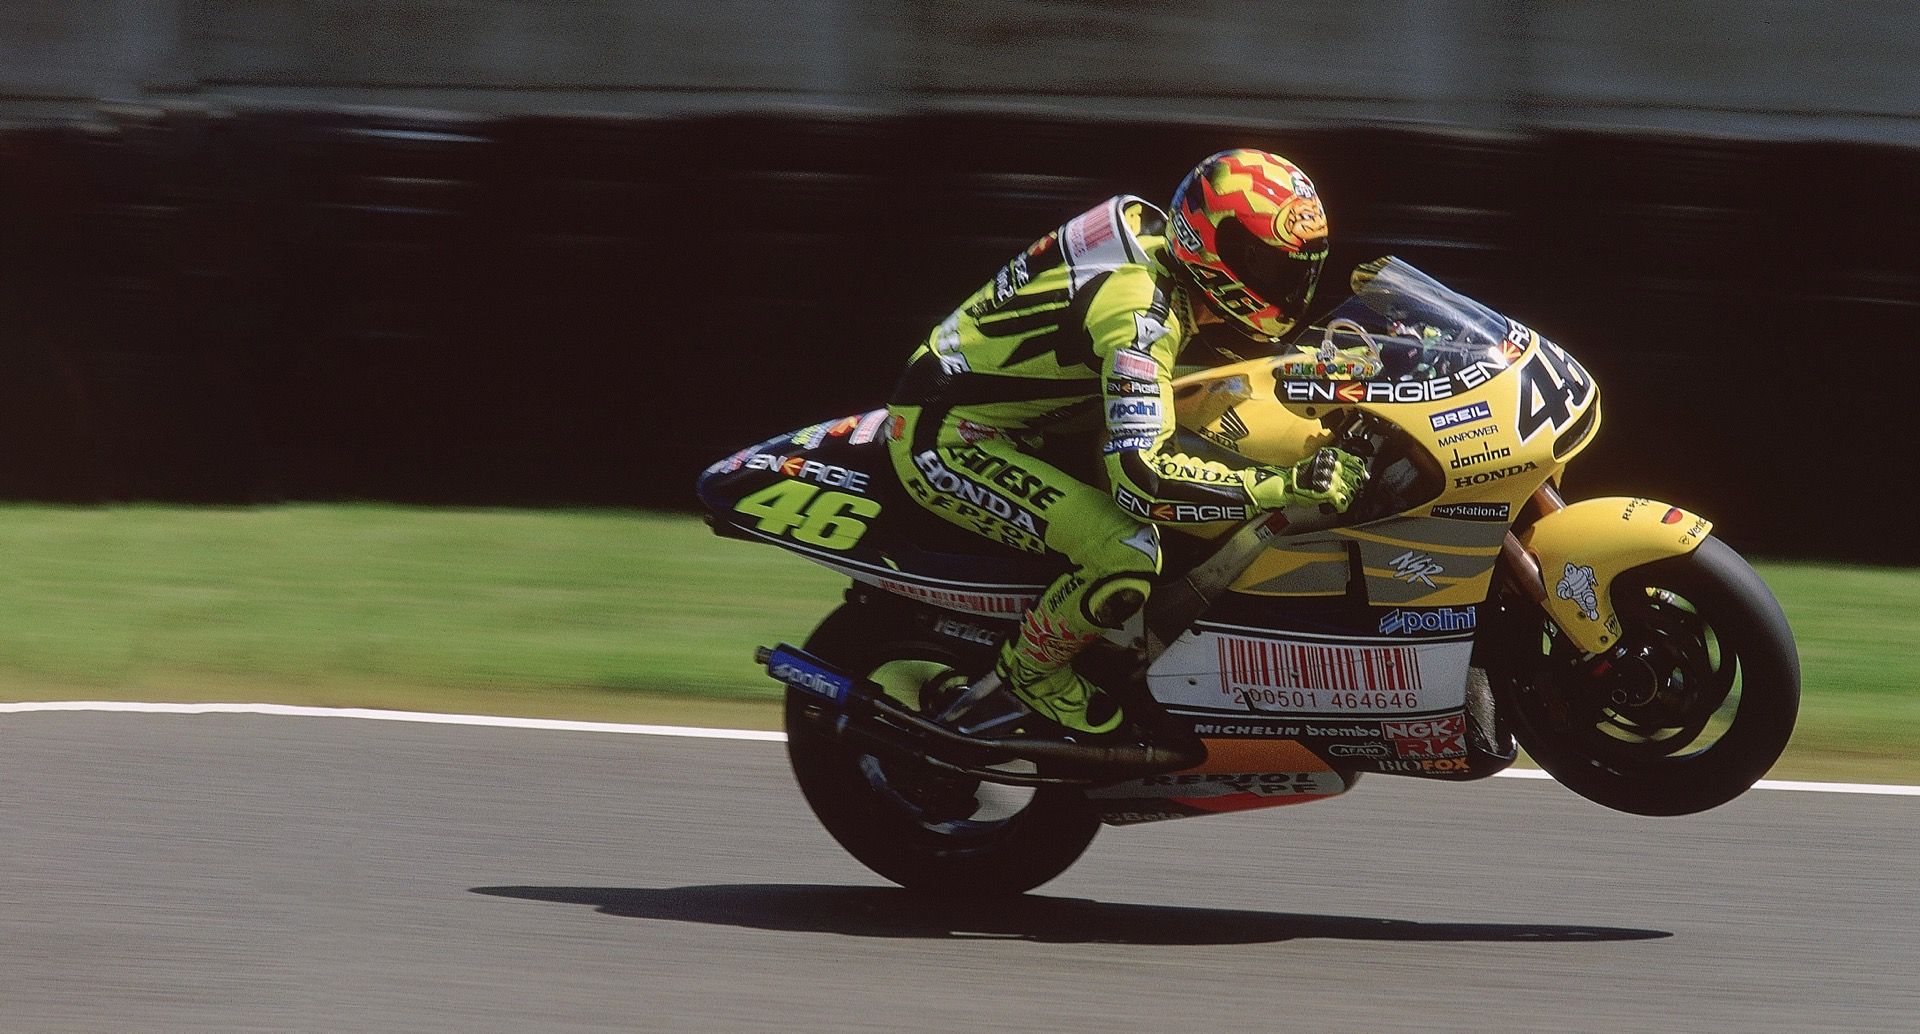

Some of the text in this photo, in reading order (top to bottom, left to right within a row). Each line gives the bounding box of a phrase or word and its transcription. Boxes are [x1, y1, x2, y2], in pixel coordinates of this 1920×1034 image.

[1315, 362, 1375, 376] DOCTOR
[1431, 405, 1490, 428] BREIL
[1437, 425, 1499, 448] MANPOWER
[1450, 441, 1511, 470] domino
[1149, 452, 1244, 484] HONDA
[1454, 461, 1538, 489] HONDA
[914, 449, 1041, 538] HONDA
[733, 479, 882, 550] 46
[1388, 550, 1444, 589] NSR
[1401, 606, 1477, 634] polini
[1232, 686, 1418, 709] 200501 464646
[1194, 723, 1300, 736] MICHELIN
[1305, 724, 1381, 737] brembo
[1385, 719, 1453, 739] NGK
[1395, 736, 1465, 756] RK
